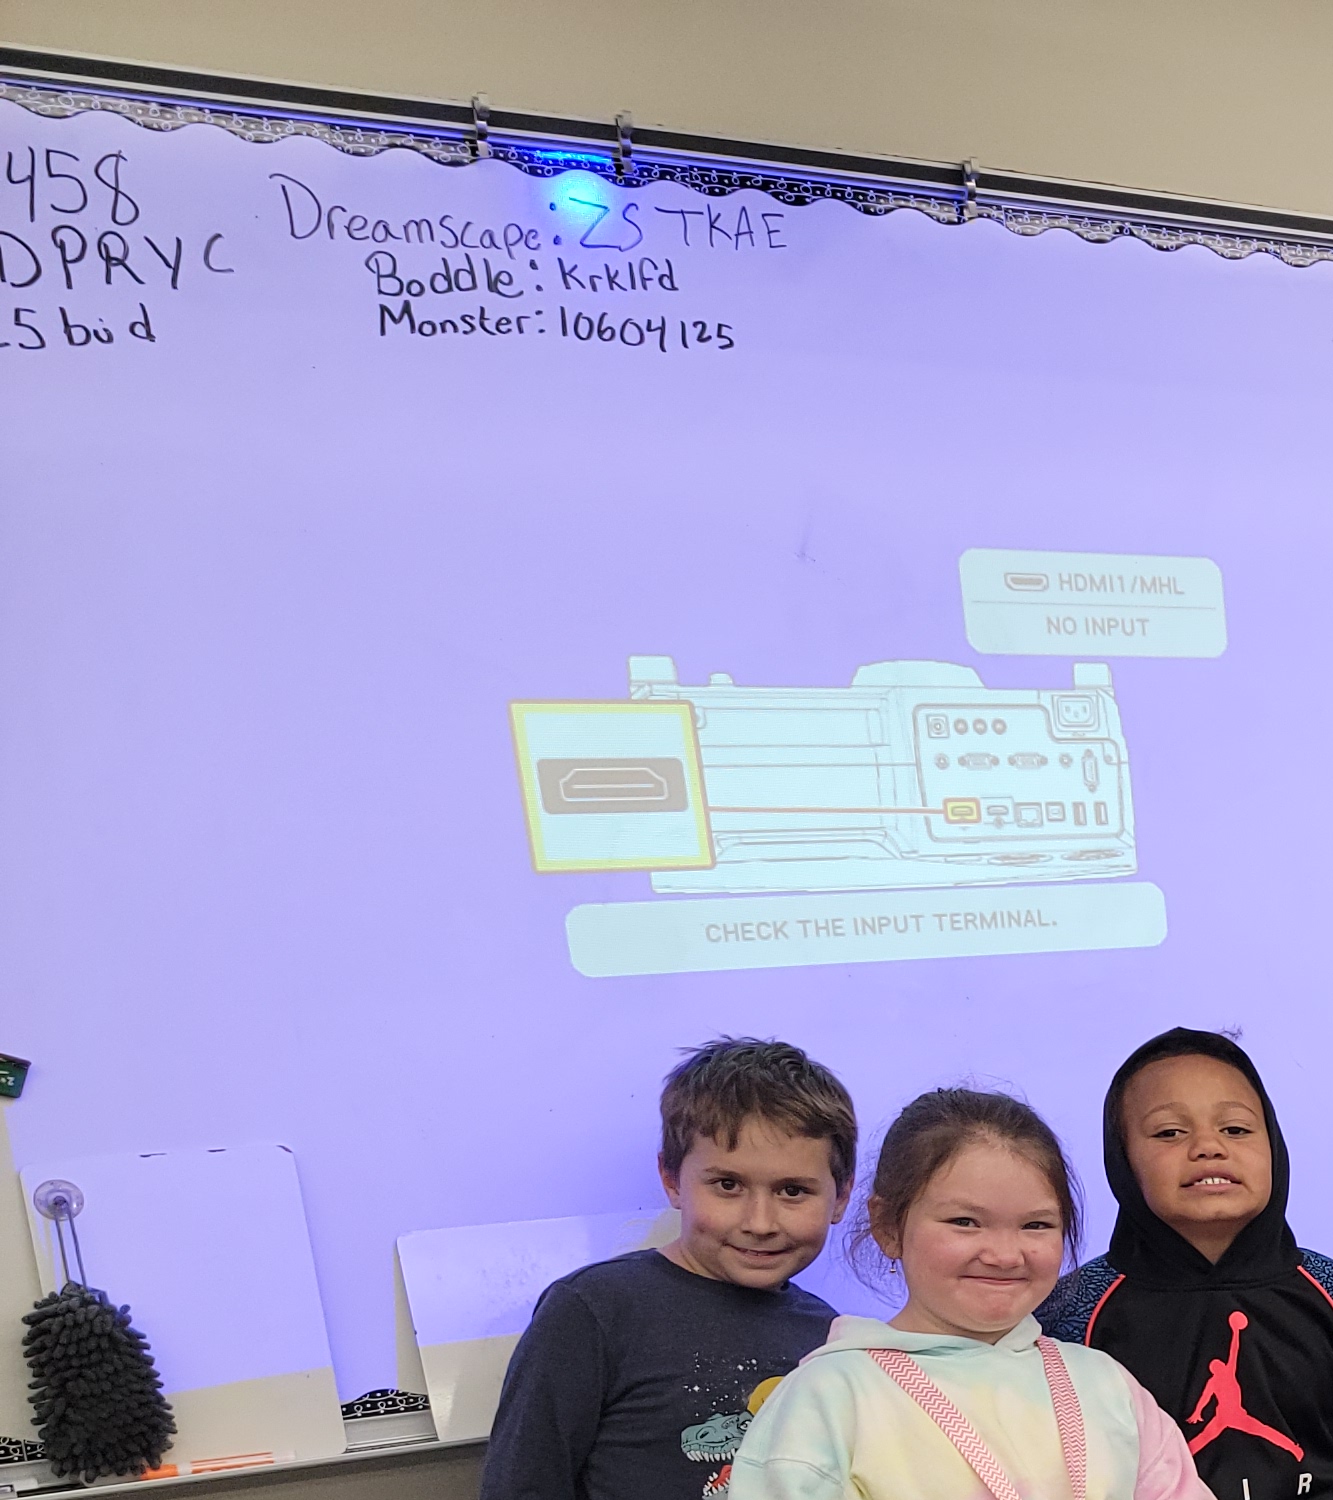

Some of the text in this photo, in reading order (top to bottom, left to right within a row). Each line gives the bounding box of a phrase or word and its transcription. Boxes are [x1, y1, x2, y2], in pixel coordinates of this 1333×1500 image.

[365, 250, 545, 299] Boddle:
[379, 303, 736, 352] Monster: 10604125
[1057, 571, 1186, 597] HDMI1/MHL
[1046, 615, 1150, 638] NO INPUT
[704, 908, 1058, 944] CHECK THE INPUT TERMINAL.
[1242, 1472, 1313, 1500] IR
